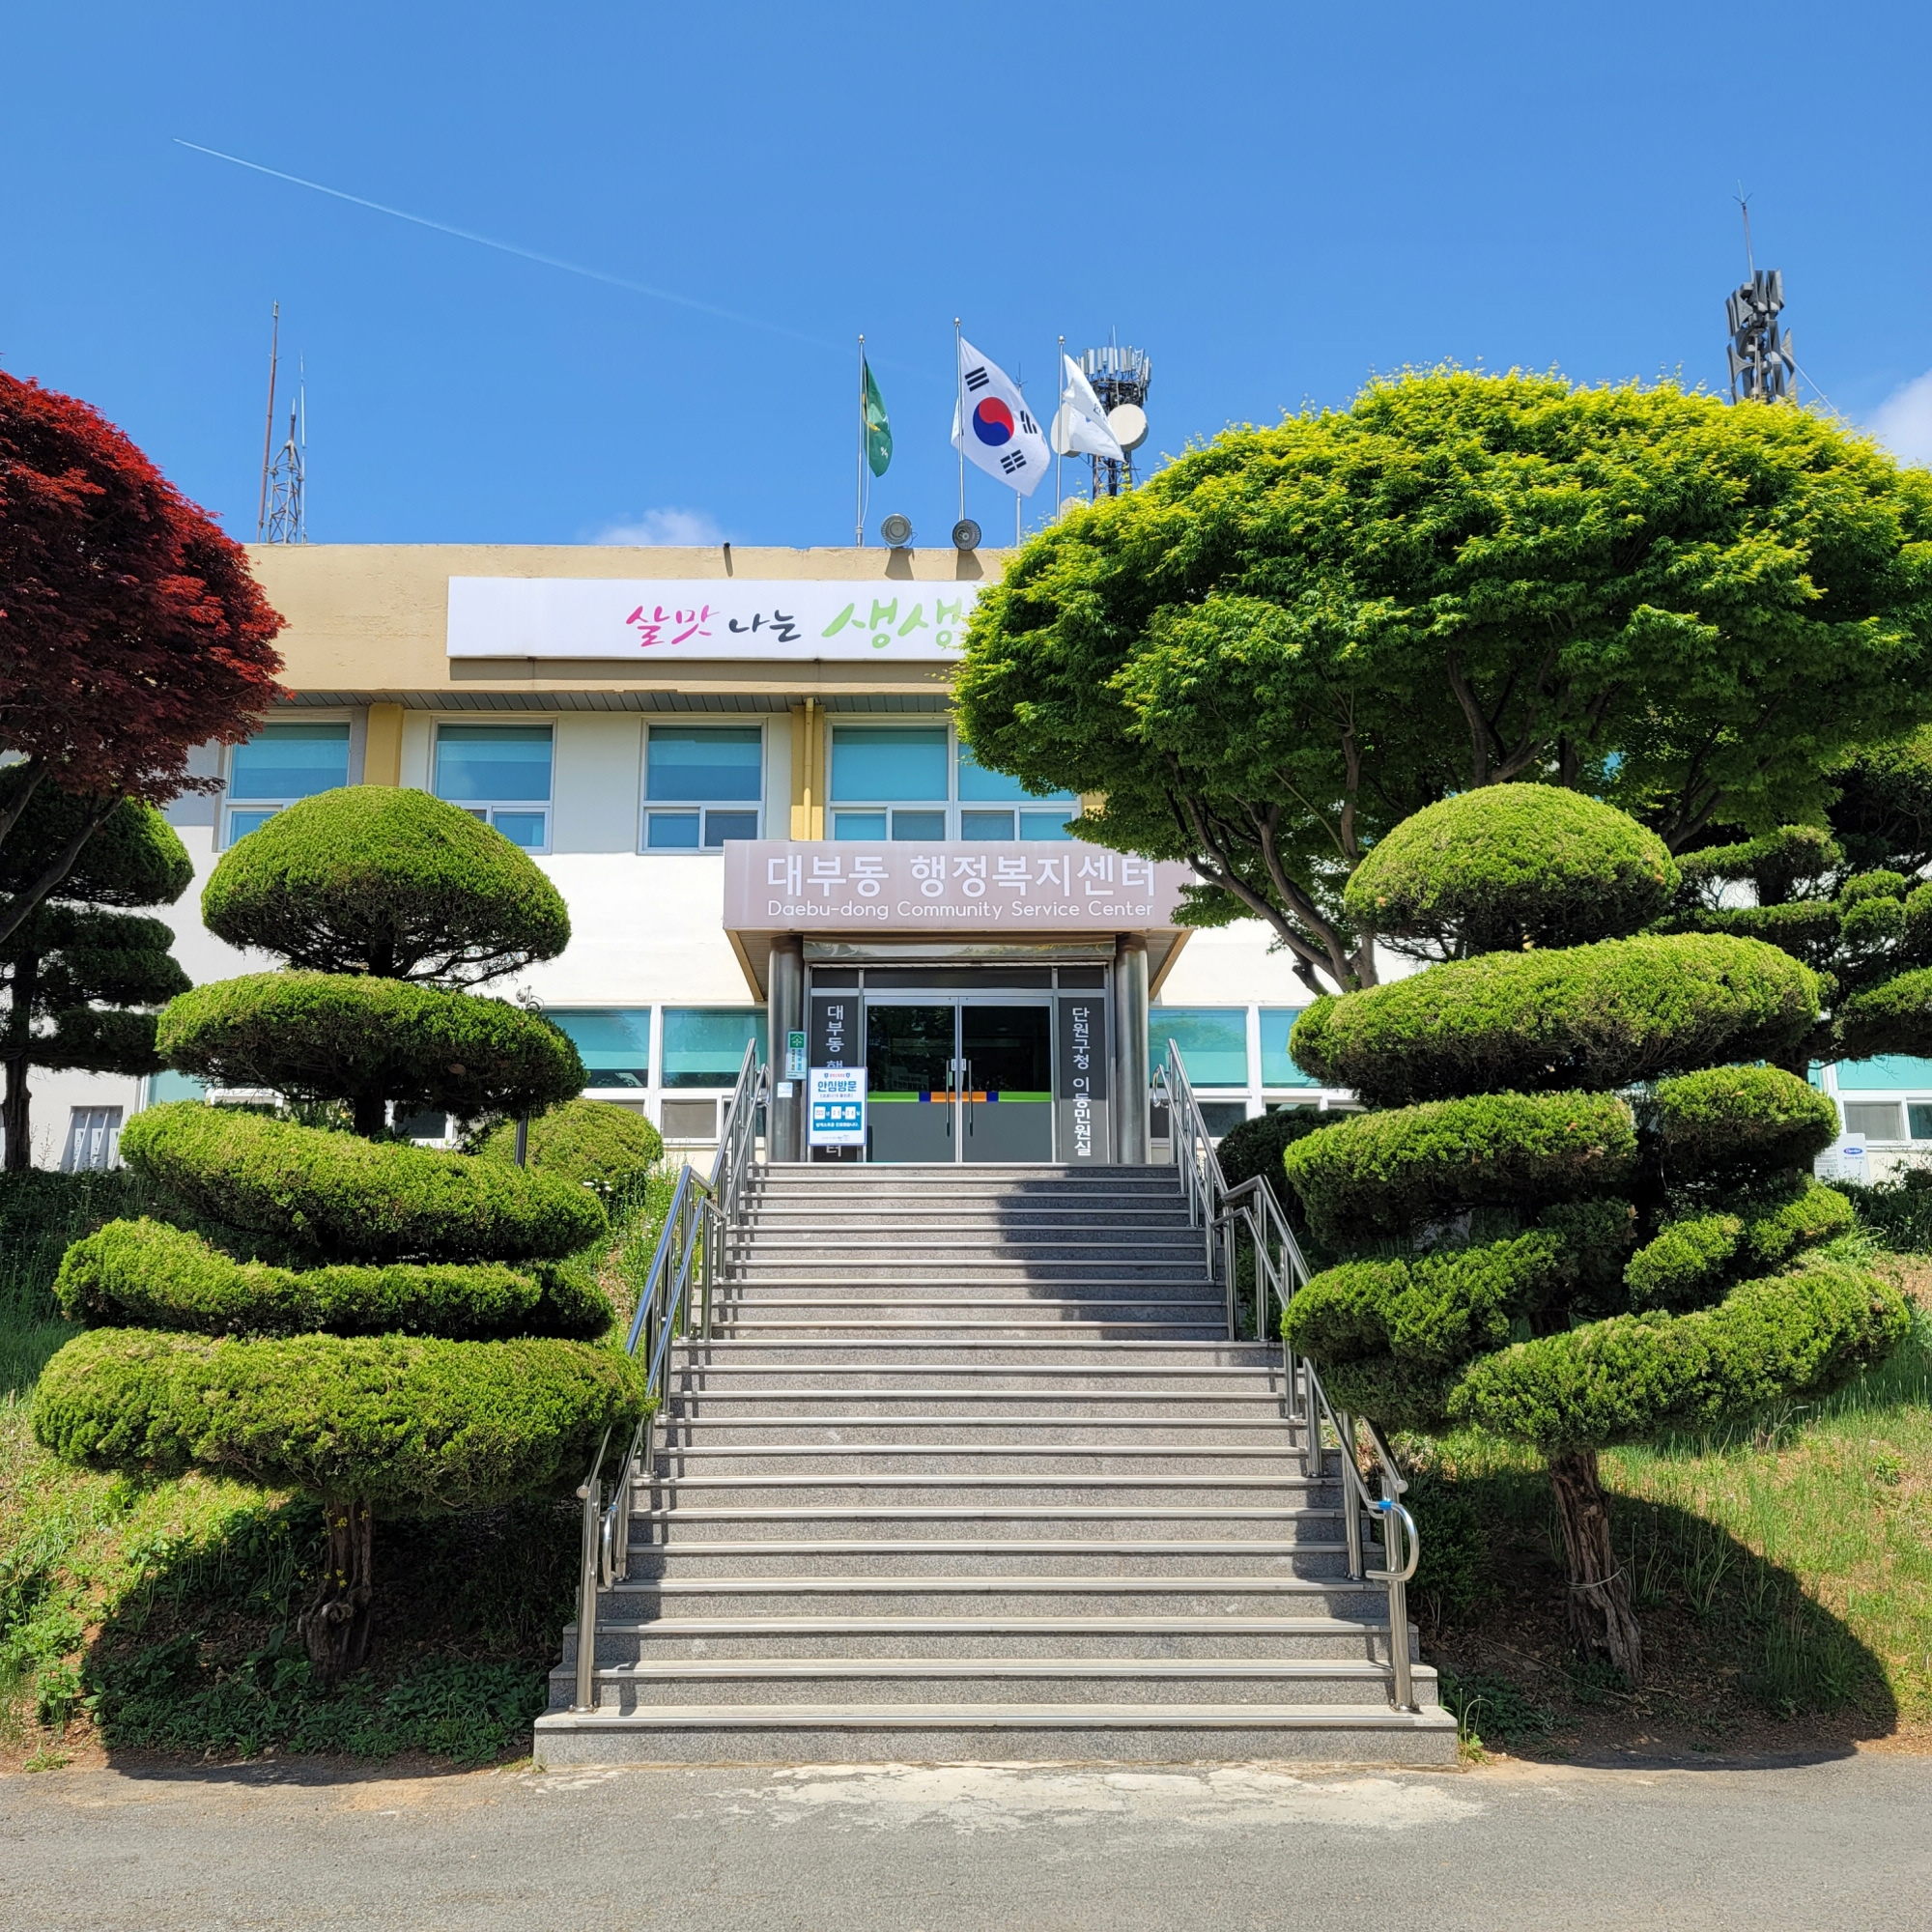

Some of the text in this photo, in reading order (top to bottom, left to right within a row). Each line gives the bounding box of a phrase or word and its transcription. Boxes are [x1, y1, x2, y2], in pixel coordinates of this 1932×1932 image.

[625, 604, 720, 647] 살맛
[728, 610, 802, 642] 나는
[767, 854, 1154, 897] 대부동 행정복지센터
[768, 899, 1153, 920] Daebu-dong Community Service Center
[825, 1005, 845, 1053] 대부동
[817, 1080, 858, 1093] 안심방문
[1071, 1007, 1093, 1156] 단원구청 이동민원실
